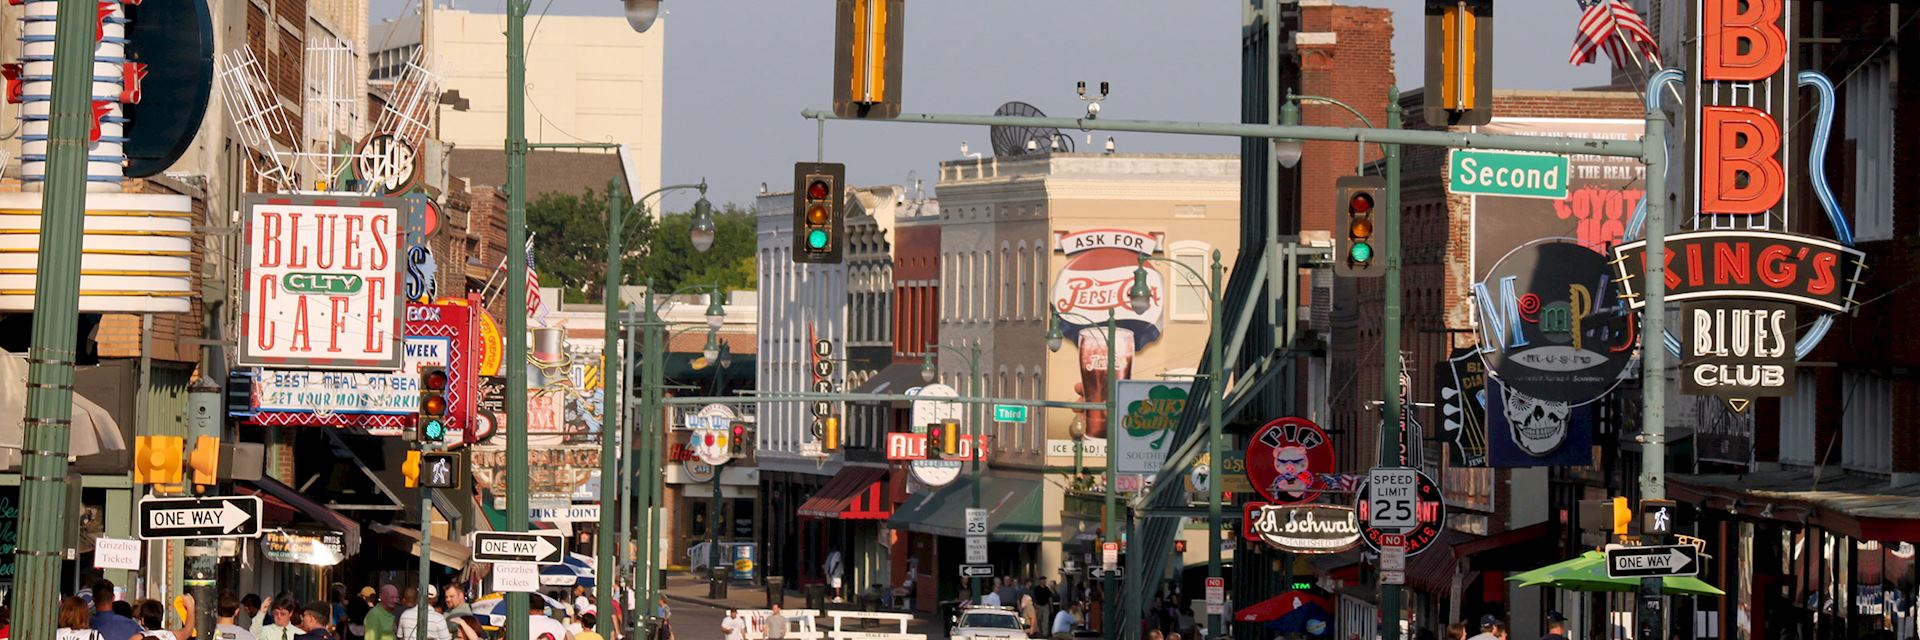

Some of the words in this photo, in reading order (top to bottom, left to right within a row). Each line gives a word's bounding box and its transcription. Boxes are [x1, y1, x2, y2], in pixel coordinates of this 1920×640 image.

[1702, 106, 1785, 214] B
[1460, 157, 1559, 190] Second
[1578, 165, 1600, 179] THE
[1604, 166, 1632, 179] REAL
[260, 212, 389, 271] BLUES
[1075, 234, 1105, 249] ASK
[1114, 233, 1144, 250] FOR
[1640, 241, 1838, 295] KING'S
[258, 274, 386, 353] CAFE
[407, 306, 441, 322] BOX
[1694, 308, 1787, 358] BLUES
[405, 344, 439, 358] WEEK
[275, 374, 310, 388] BEST
[391, 378, 420, 391] BEAL
[1694, 364, 1786, 388] CLUB
[999, 408, 1022, 419] Third
[1259, 423, 1324, 450] PIG
[1053, 445, 1067, 454] ICE
[1374, 475, 1413, 485] SPEED
[1378, 487, 1408, 497] LIMIT
[529, 508, 558, 518] JUKE
[565, 508, 598, 518] JOINT
[1375, 499, 1412, 521] 25
[154, 511, 185, 526] ONE
[191, 510, 224, 525] WAY
[968, 523, 985, 533] 25
[98, 540, 138, 551] Grizzlies
[485, 541, 508, 553] ONE
[513, 541, 537, 553] WAY
[1385, 536, 1401, 545] NO
[103, 554, 133, 564] Tickets
[1619, 556, 1643, 569] ONE
[1647, 555, 1671, 567] WAY
[500, 578, 530, 588] Tickets
